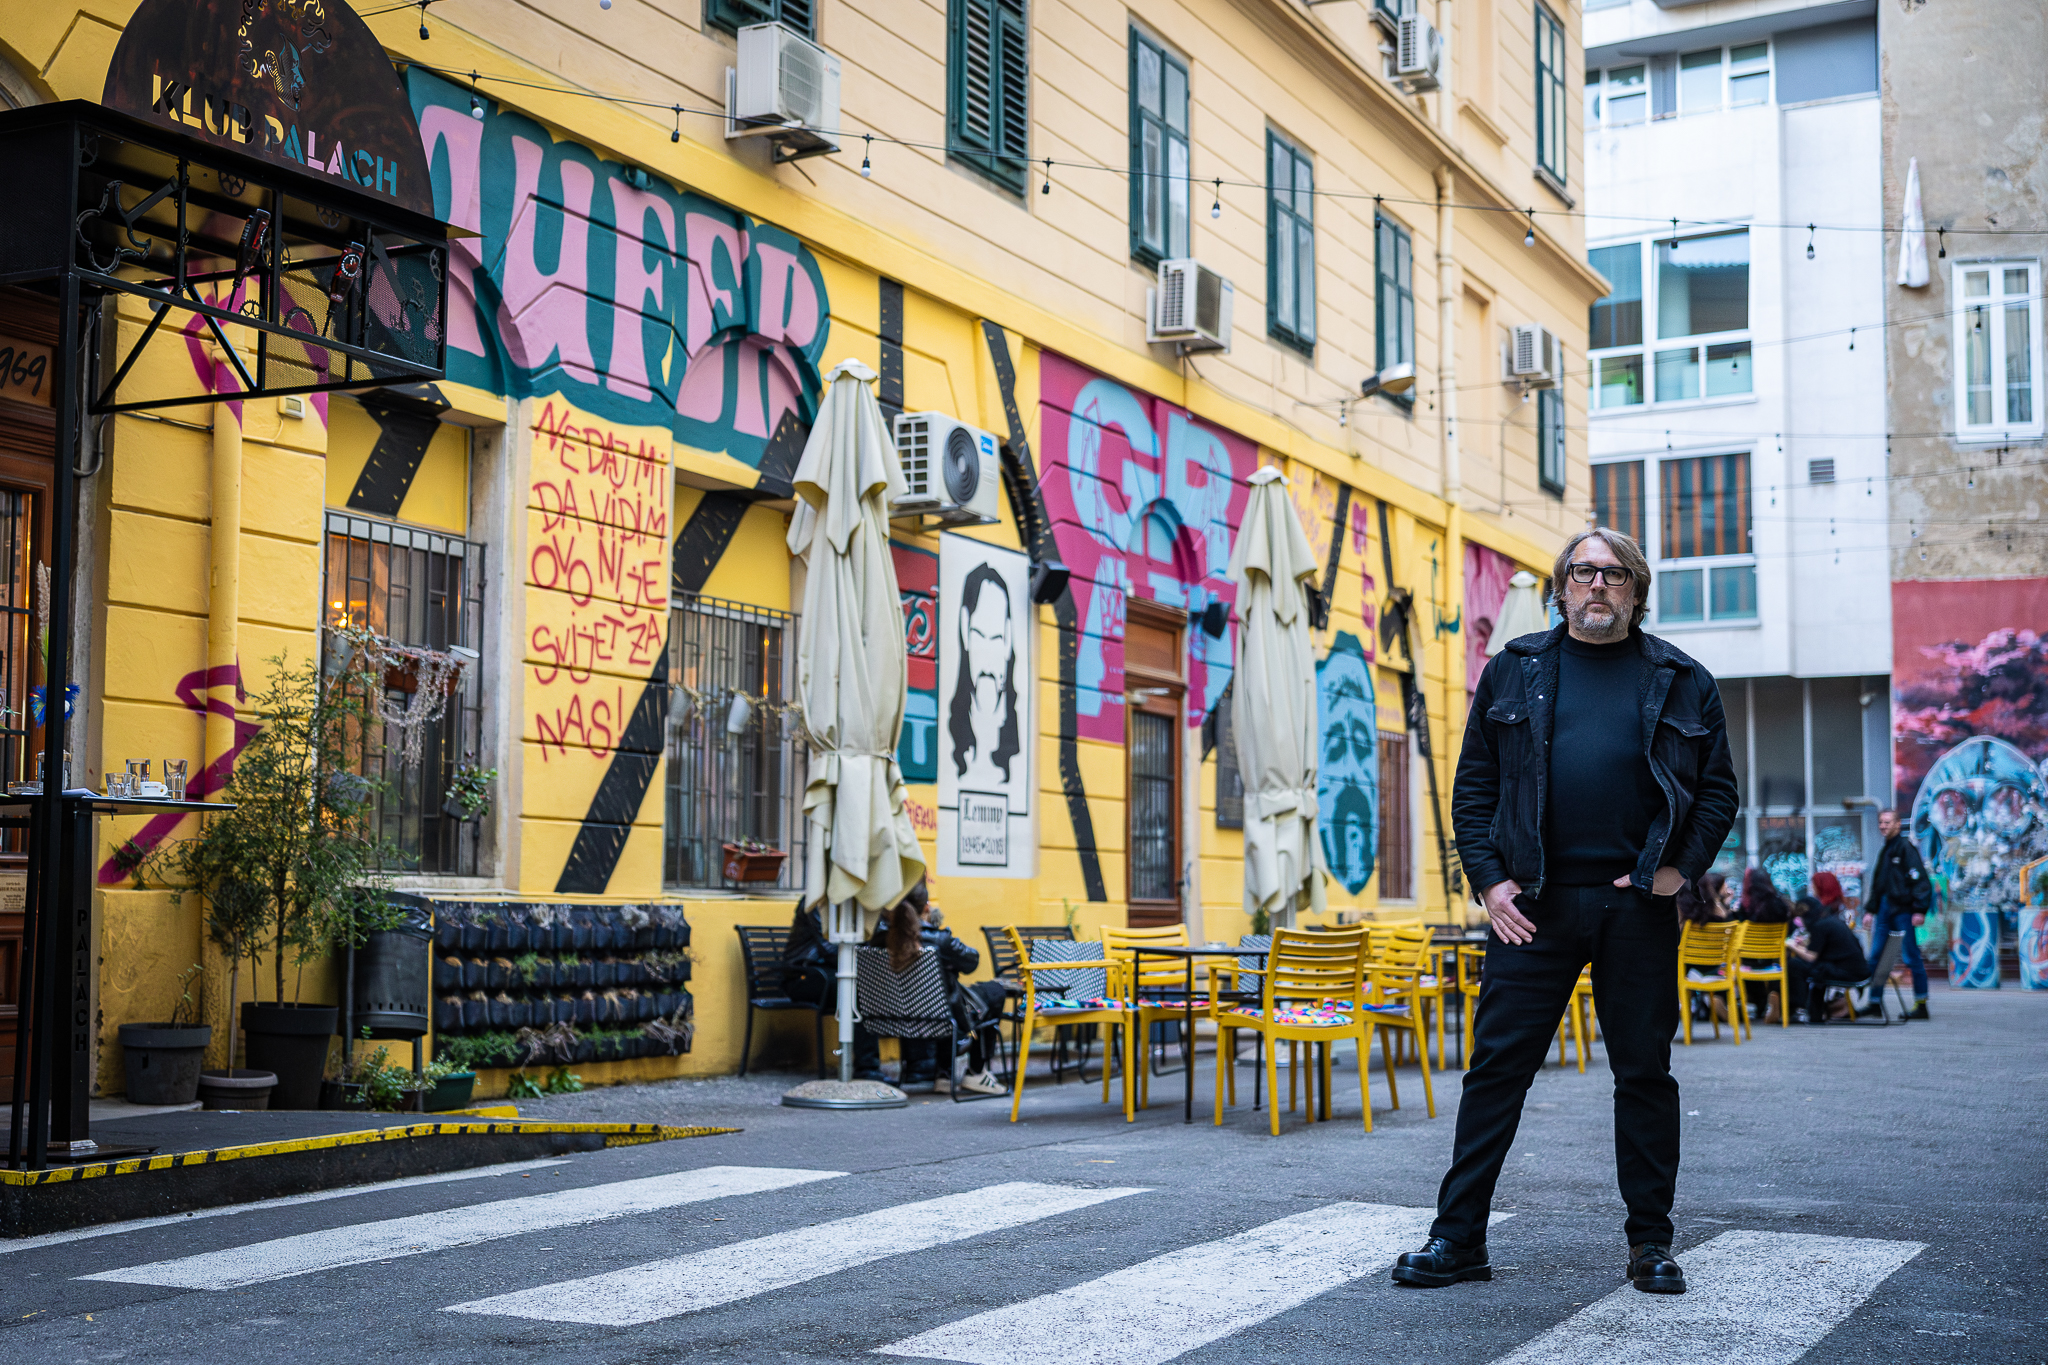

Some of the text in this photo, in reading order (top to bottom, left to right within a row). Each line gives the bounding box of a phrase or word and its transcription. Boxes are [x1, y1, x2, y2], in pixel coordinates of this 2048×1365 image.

[152, 73, 398, 197] KLUB PALACH
[532, 479, 582, 534] DA
[532, 534, 593, 607] OVO
[626, 613, 661, 665] ZA
[536, 686, 623, 763] NAS!
[75, 909, 88, 1051] PALACH
